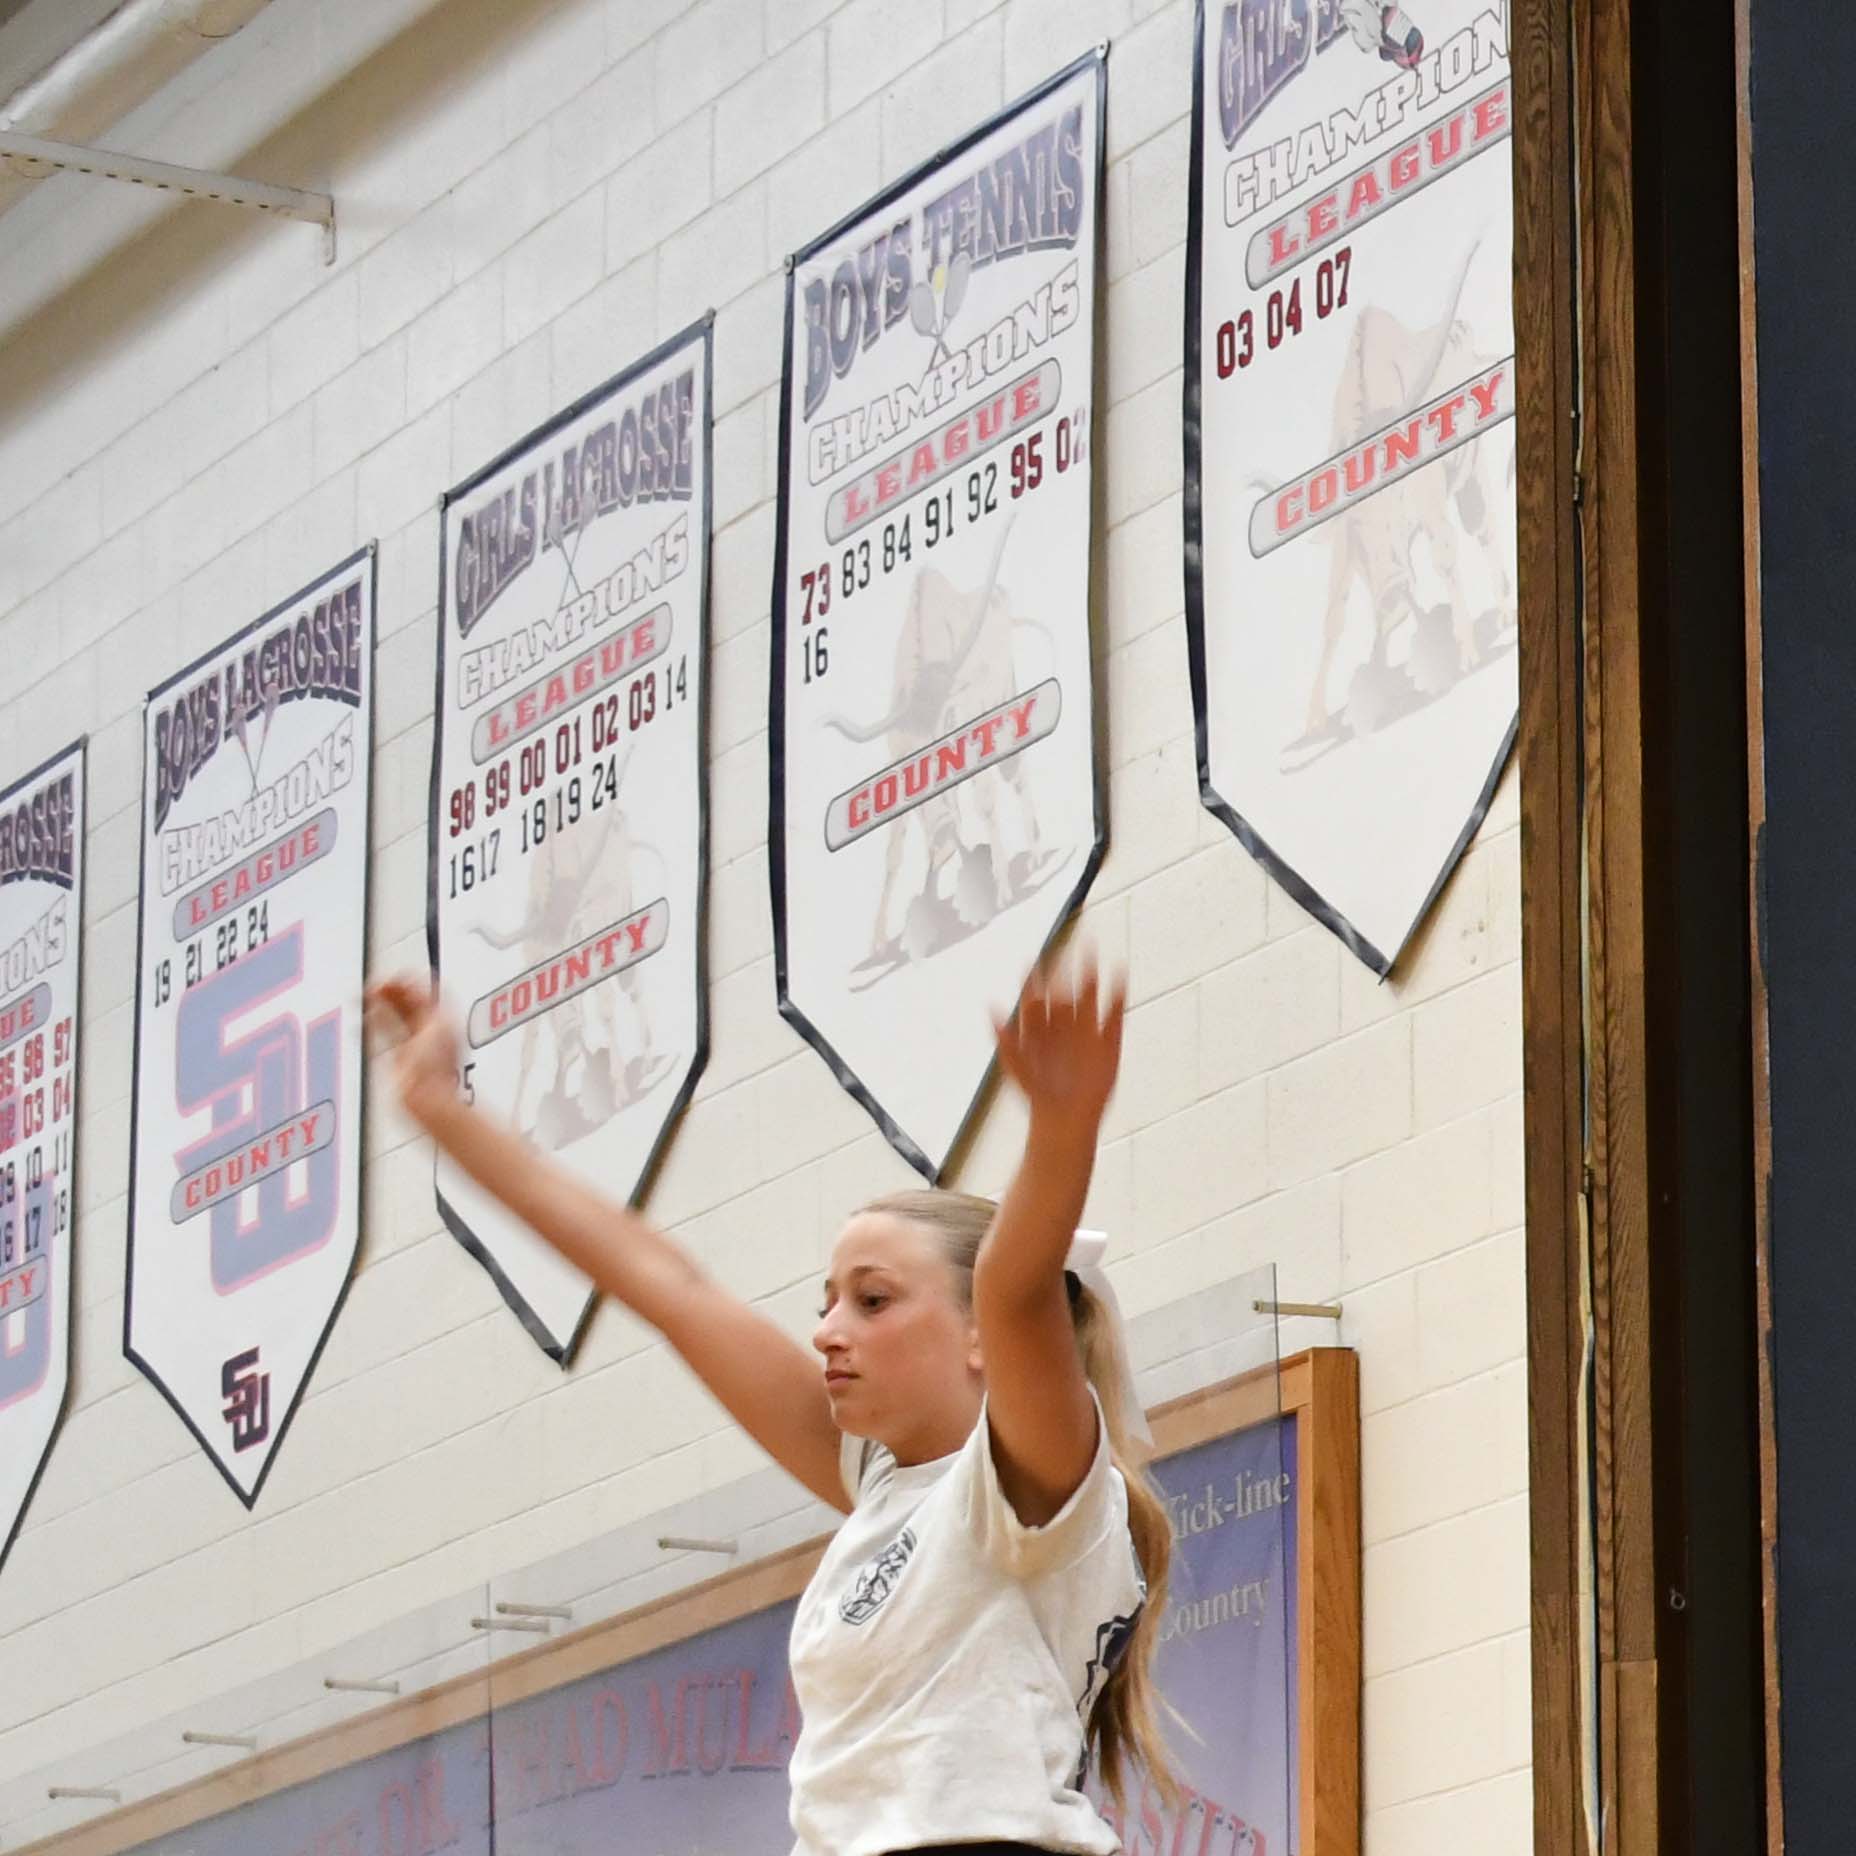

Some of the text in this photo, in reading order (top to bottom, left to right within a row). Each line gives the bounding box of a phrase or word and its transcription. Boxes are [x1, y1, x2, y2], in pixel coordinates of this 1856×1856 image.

[1224, 0, 1511, 229] CHAMPION
[1268, 88, 1507, 268] LEAGUE
[804, 103, 1084, 424] BOYS TENNIS
[1216, 245, 1352, 380] 03 04 07
[808, 257, 1080, 487] CHAMPIONS
[455, 367, 694, 640] GIRLS LACROSSE
[843, 375, 1042, 525] LEAGUE
[1276, 371, 1504, 532] COUNTY
[800, 561, 831, 627] 73
[842, 538, 871, 600] 83
[882, 513, 911, 574] 84
[925, 486, 954, 549] 91
[967, 461, 997, 523] 92
[1010, 430, 1043, 500] 95
[458, 511, 689, 710] CHAMPIONS
[486, 617, 656, 747] LEAGUE
[803, 627, 829, 685] 16
[156, 577, 362, 836] BOYS LACROSSE
[450, 654, 687, 838] 98 99 00 01 02 03 14
[847, 697, 1038, 831] COUNTY
[161, 711, 354, 897] CHAMPIONS
[189, 822, 321, 926] LEAGUE
[521, 798, 546, 854] 18
[556, 776, 581, 833] 19
[592, 753, 617, 811] 24
[155, 958, 172, 1008] 19
[186, 939, 202, 988] 21
[248, 899, 268, 952] 24
[490, 914, 650, 1030] COUNTY
[184, 1113, 321, 1211] COUNTY
[641, 1669, 802, 1780] MULA
